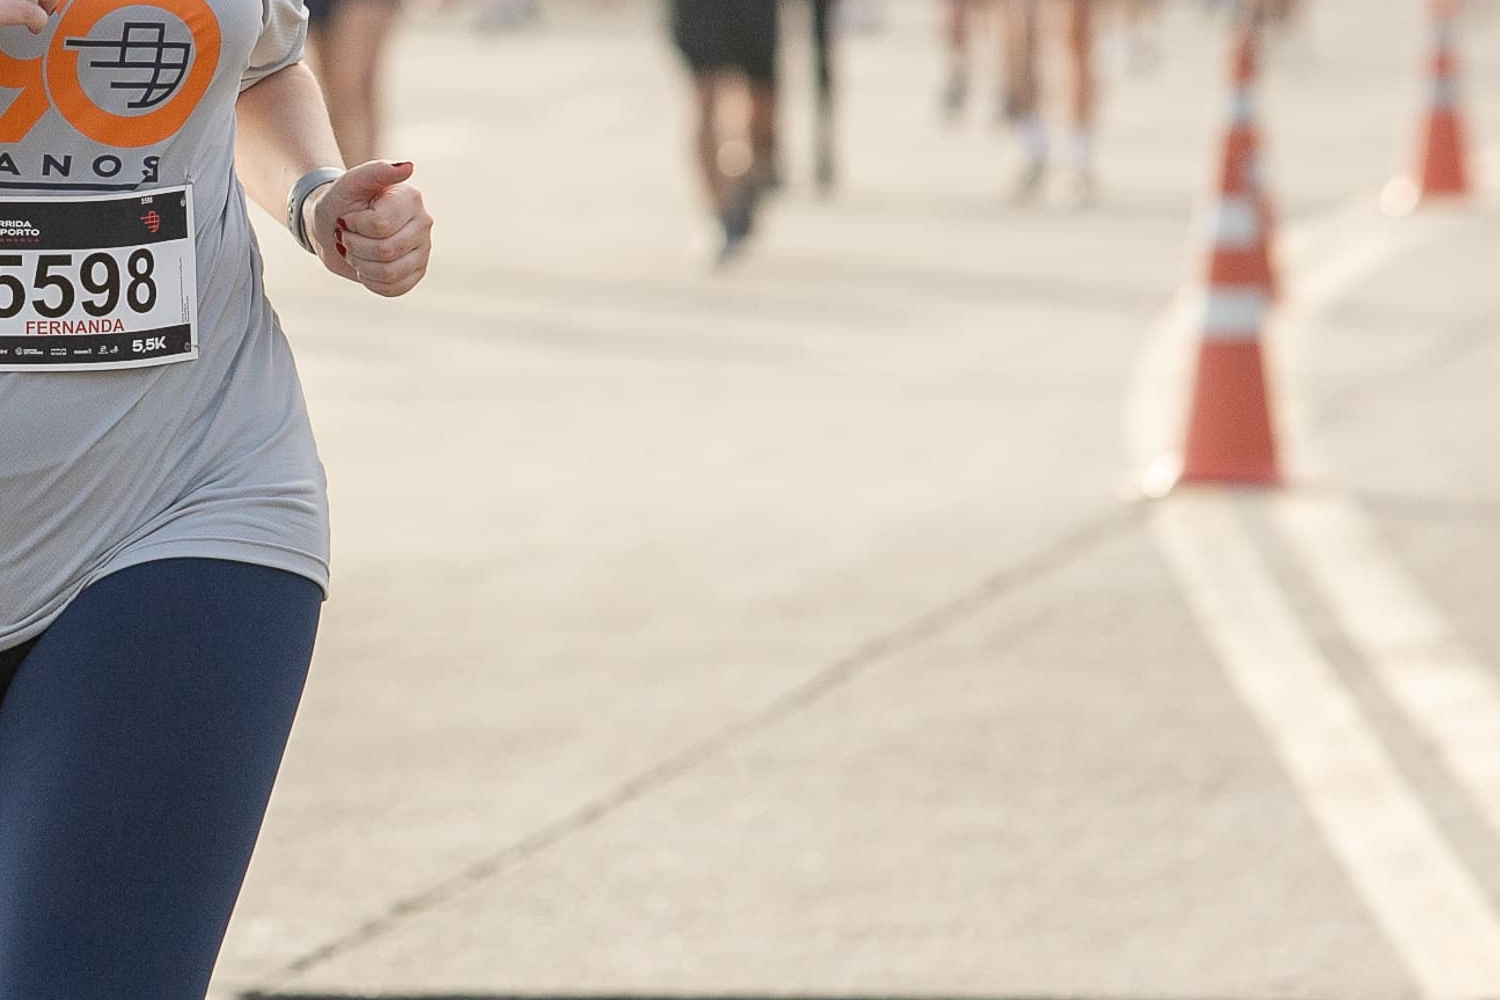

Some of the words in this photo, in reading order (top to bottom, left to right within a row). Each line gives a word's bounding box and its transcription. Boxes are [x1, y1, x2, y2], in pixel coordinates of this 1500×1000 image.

[0, 228, 41, 237] PORTO
[24, 318, 125, 335] FERNANDA
[131, 335, 167, 353] 5,5K
